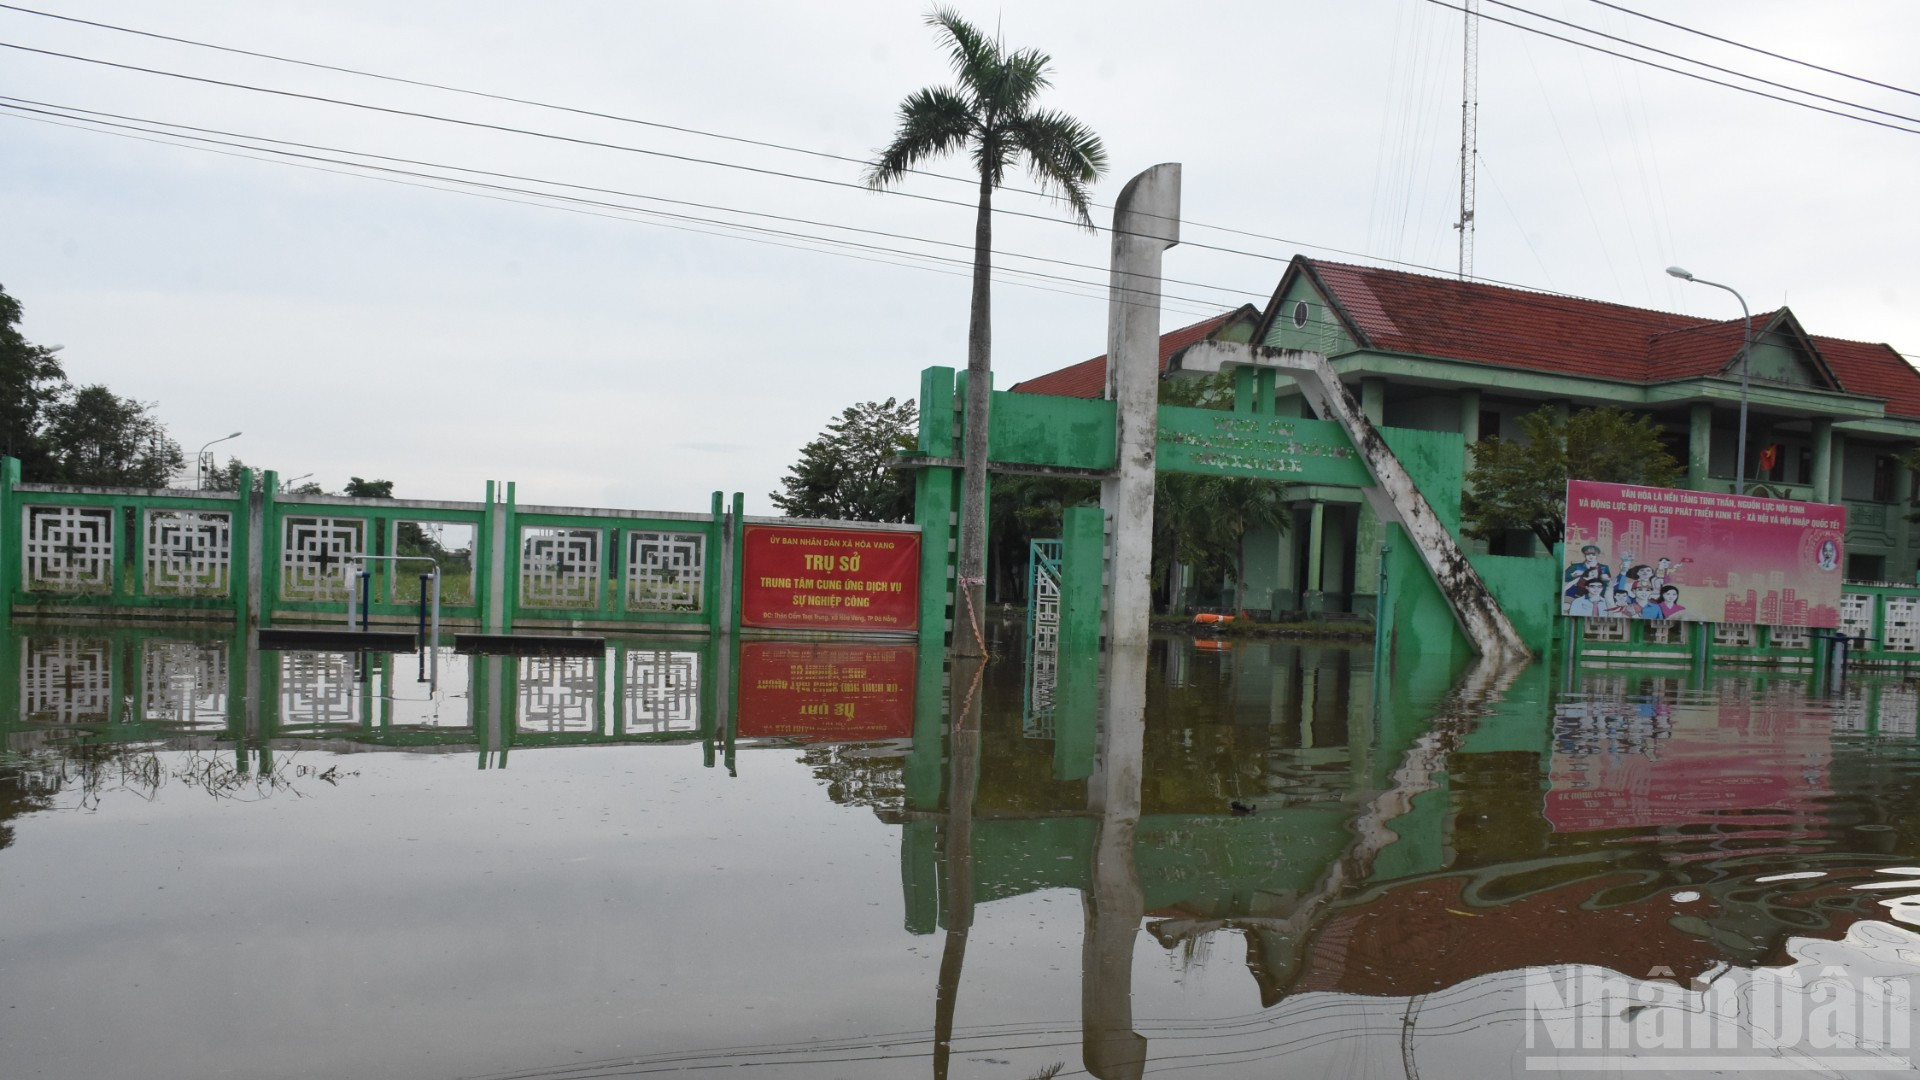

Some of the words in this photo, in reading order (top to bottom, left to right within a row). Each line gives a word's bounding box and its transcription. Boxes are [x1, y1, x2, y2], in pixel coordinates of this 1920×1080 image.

[1579, 498, 1589, 508] VÀ
[1659, 505, 1673, 514] CHO
[1715, 510, 1732, 520] KINH
[1622, 489, 1636, 499] VĂN
[1654, 492, 1662, 501] LÀ
[1700, 496, 1715, 506] TINH
[1789, 505, 1805, 514] SINH
[770, 534, 780, 544] ỦY
[800, 537, 822, 546] NHÂN
[824, 538, 840, 547] DÂN
[842, 538, 852, 548] XÃ
[804, 554, 834, 574] TRỤ
[839, 551, 860, 572] SỞ
[760, 577, 791, 588] TRUNG
[794, 577, 814, 589] TÂM
[816, 579, 842, 590] CUNG
[844, 579, 864, 591] ỨNG
[866, 581, 888, 594] DỊCH
[890, 582, 902, 594] VỤ
[792, 594, 807, 607] SỰ
[808, 594, 842, 608] NGHIỆP
[845, 595, 870, 608] CÔNG
